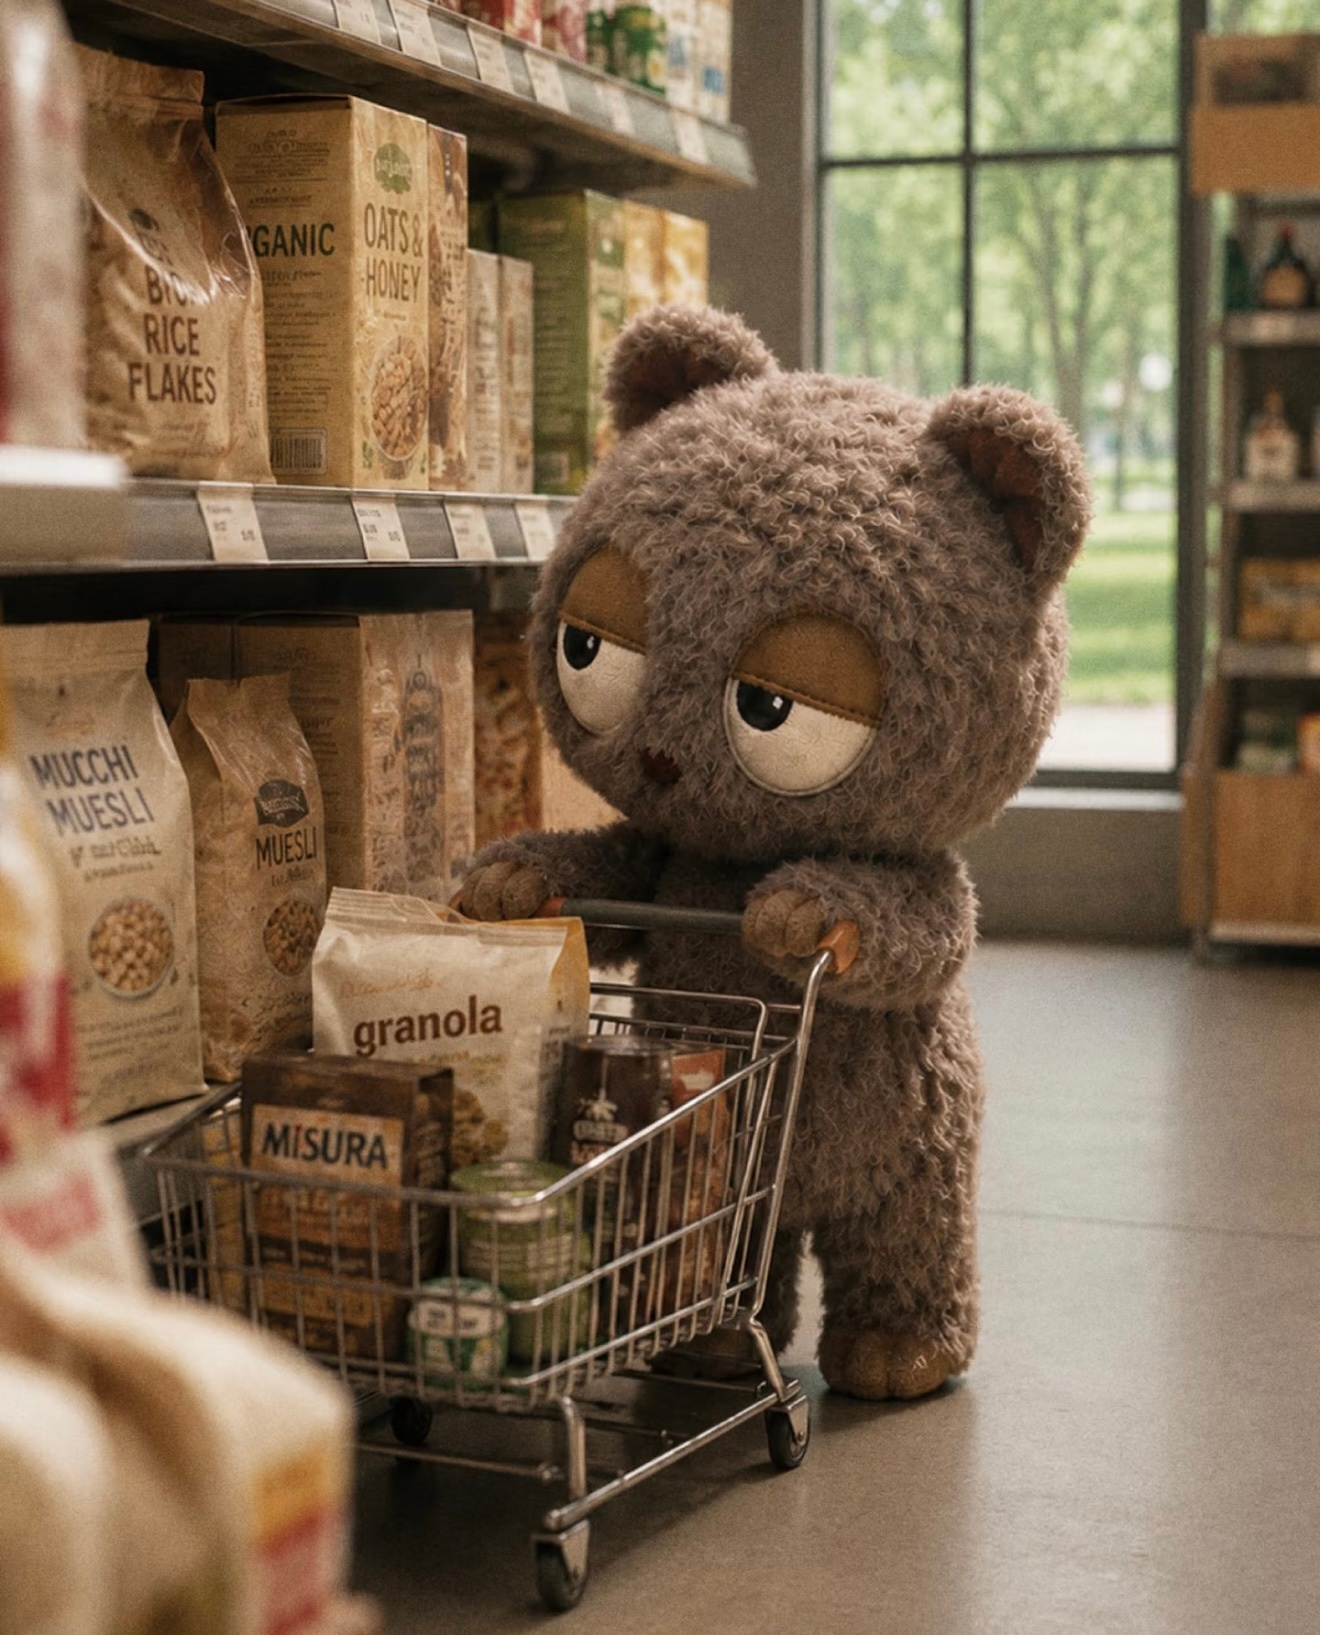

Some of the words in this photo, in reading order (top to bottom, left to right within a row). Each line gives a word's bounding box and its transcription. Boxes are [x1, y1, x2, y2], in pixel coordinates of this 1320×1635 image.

[247, 223, 335, 257] GANIC
[364, 202, 409, 255] OATS
[412, 213, 423, 257] &
[366, 256, 421, 303] HONEY
[143, 313, 200, 356] RICE
[128, 362, 217, 405] FLAKES
[30, 745, 139, 790] MUCCHI
[47, 787, 155, 837] MUESLI
[256, 826, 317, 870] MUESLI
[354, 994, 503, 1059] granola
